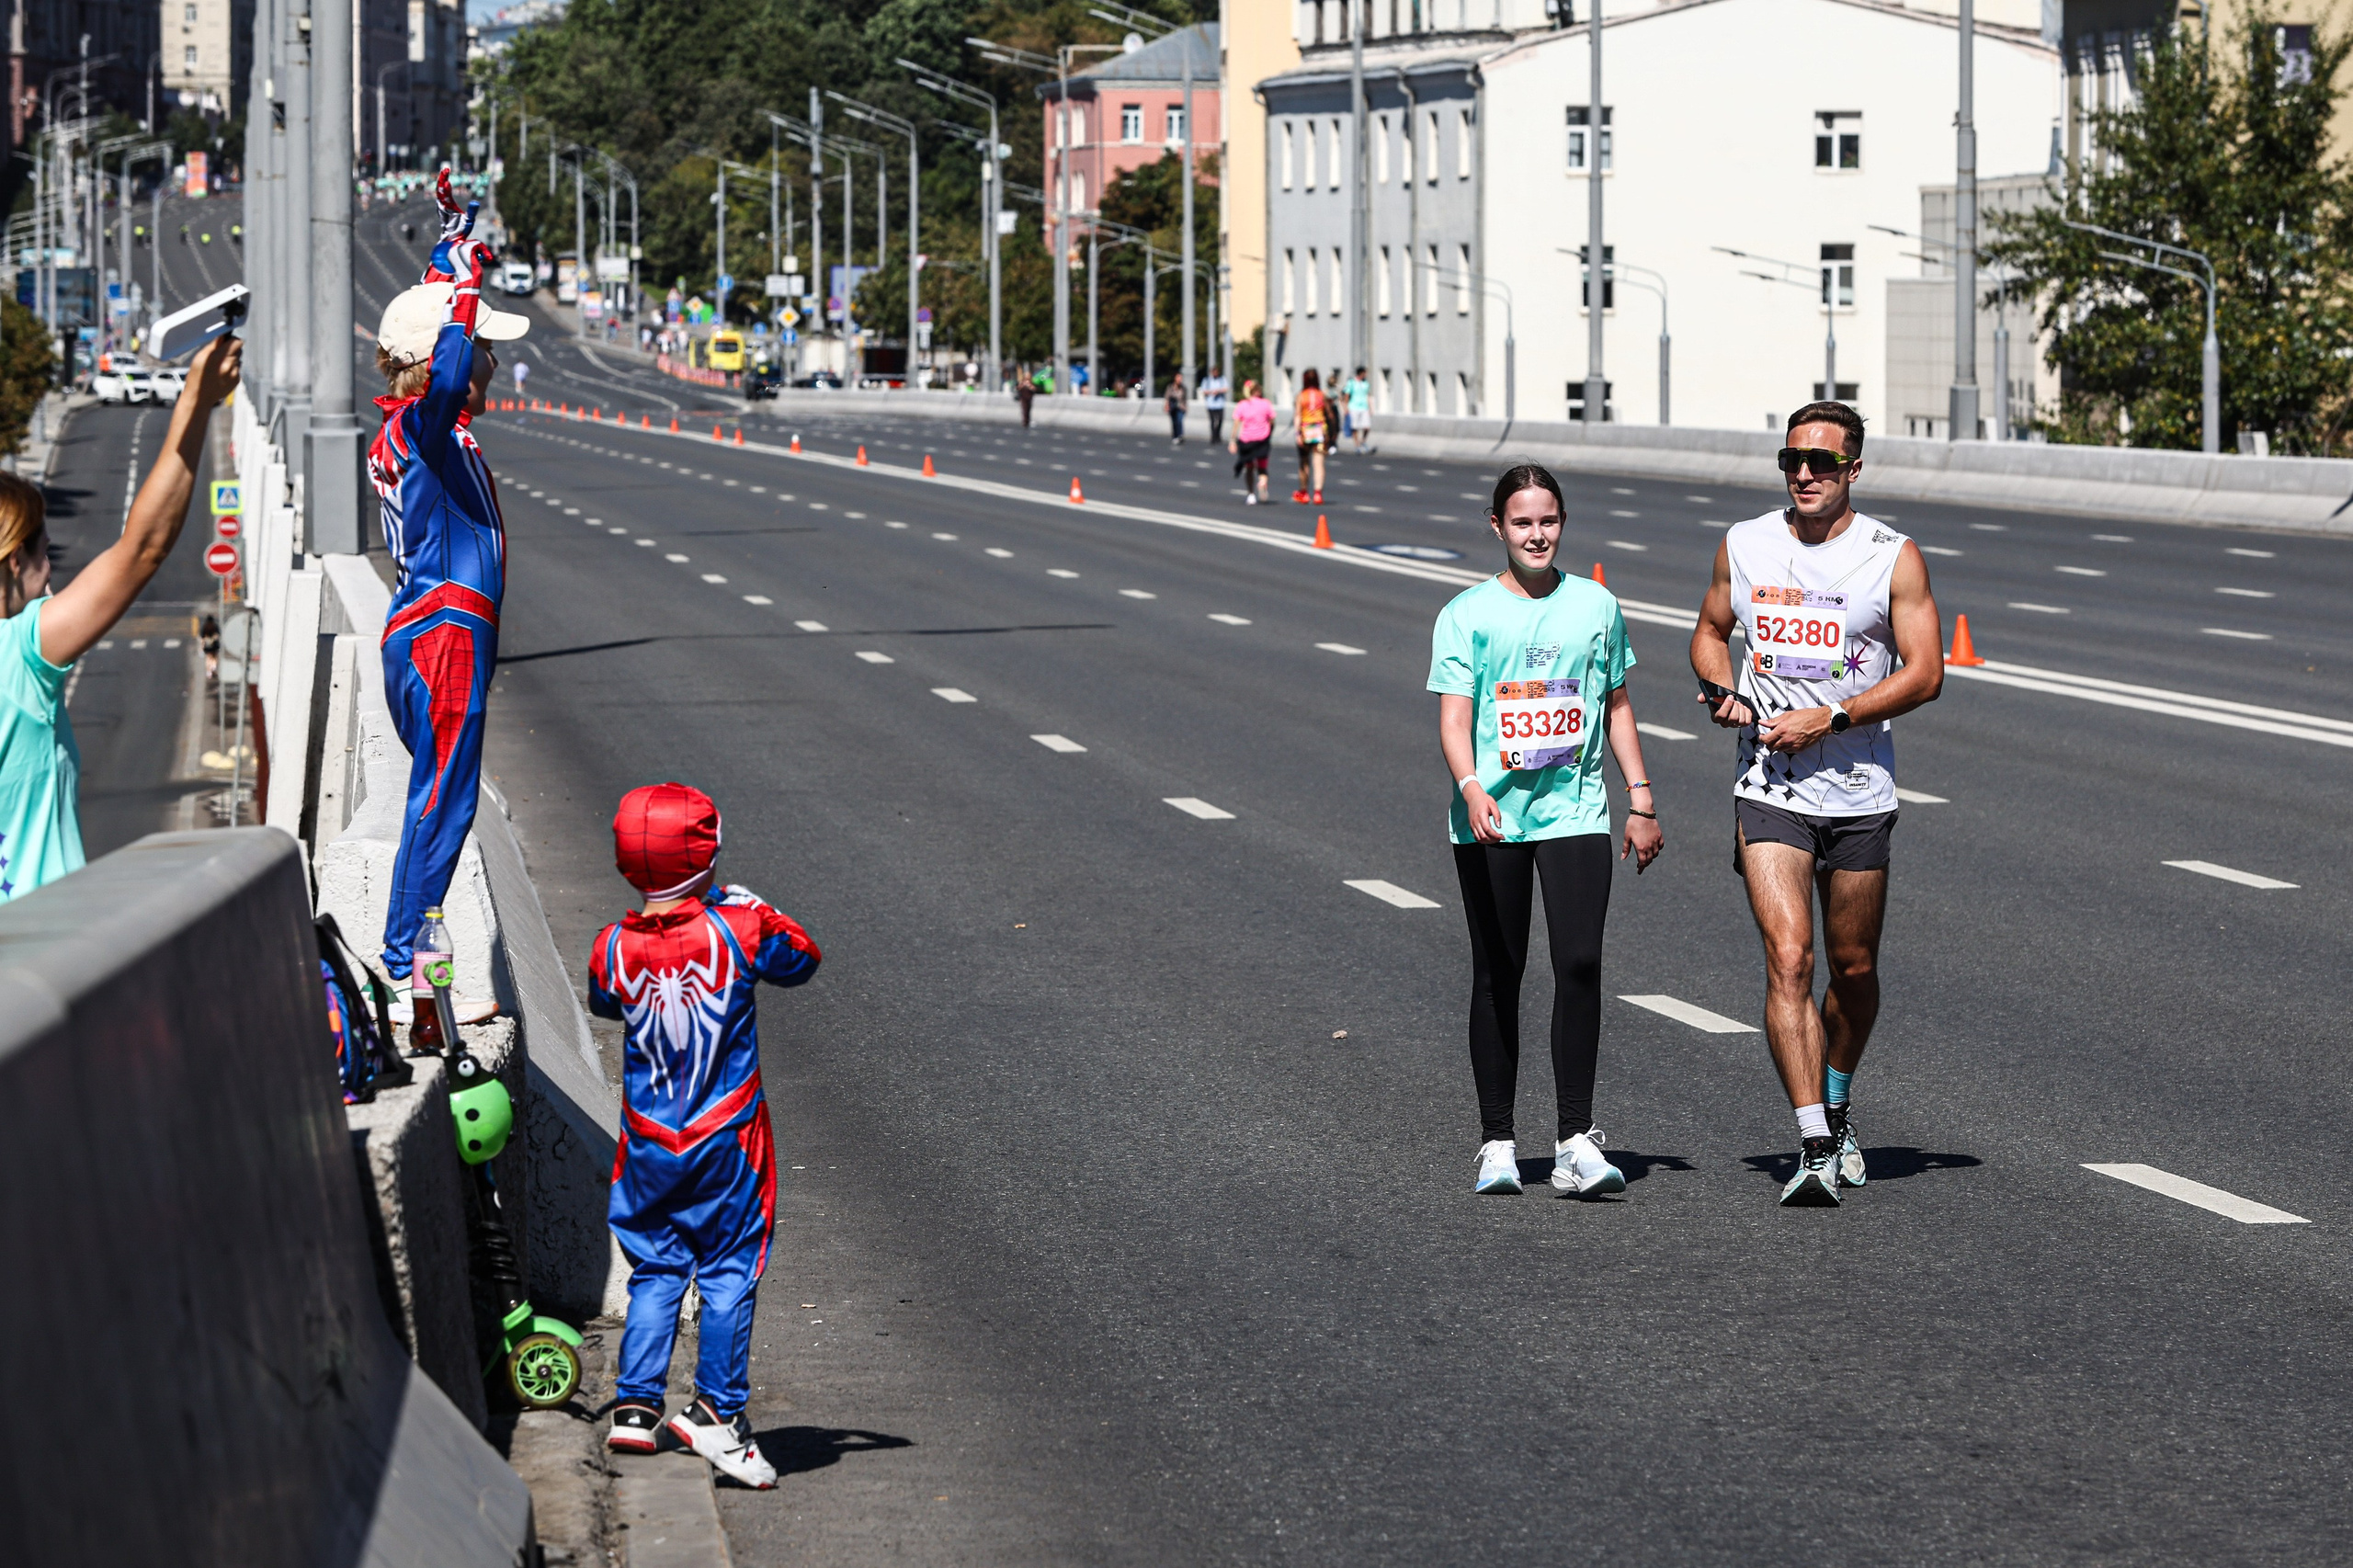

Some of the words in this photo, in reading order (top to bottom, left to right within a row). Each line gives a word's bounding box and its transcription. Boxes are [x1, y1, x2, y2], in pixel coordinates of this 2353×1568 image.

[1756, 615, 1840, 648] 52380
[1765, 654, 1773, 669] B
[1501, 708, 1582, 739] 53328
[1511, 751, 1521, 766] C
